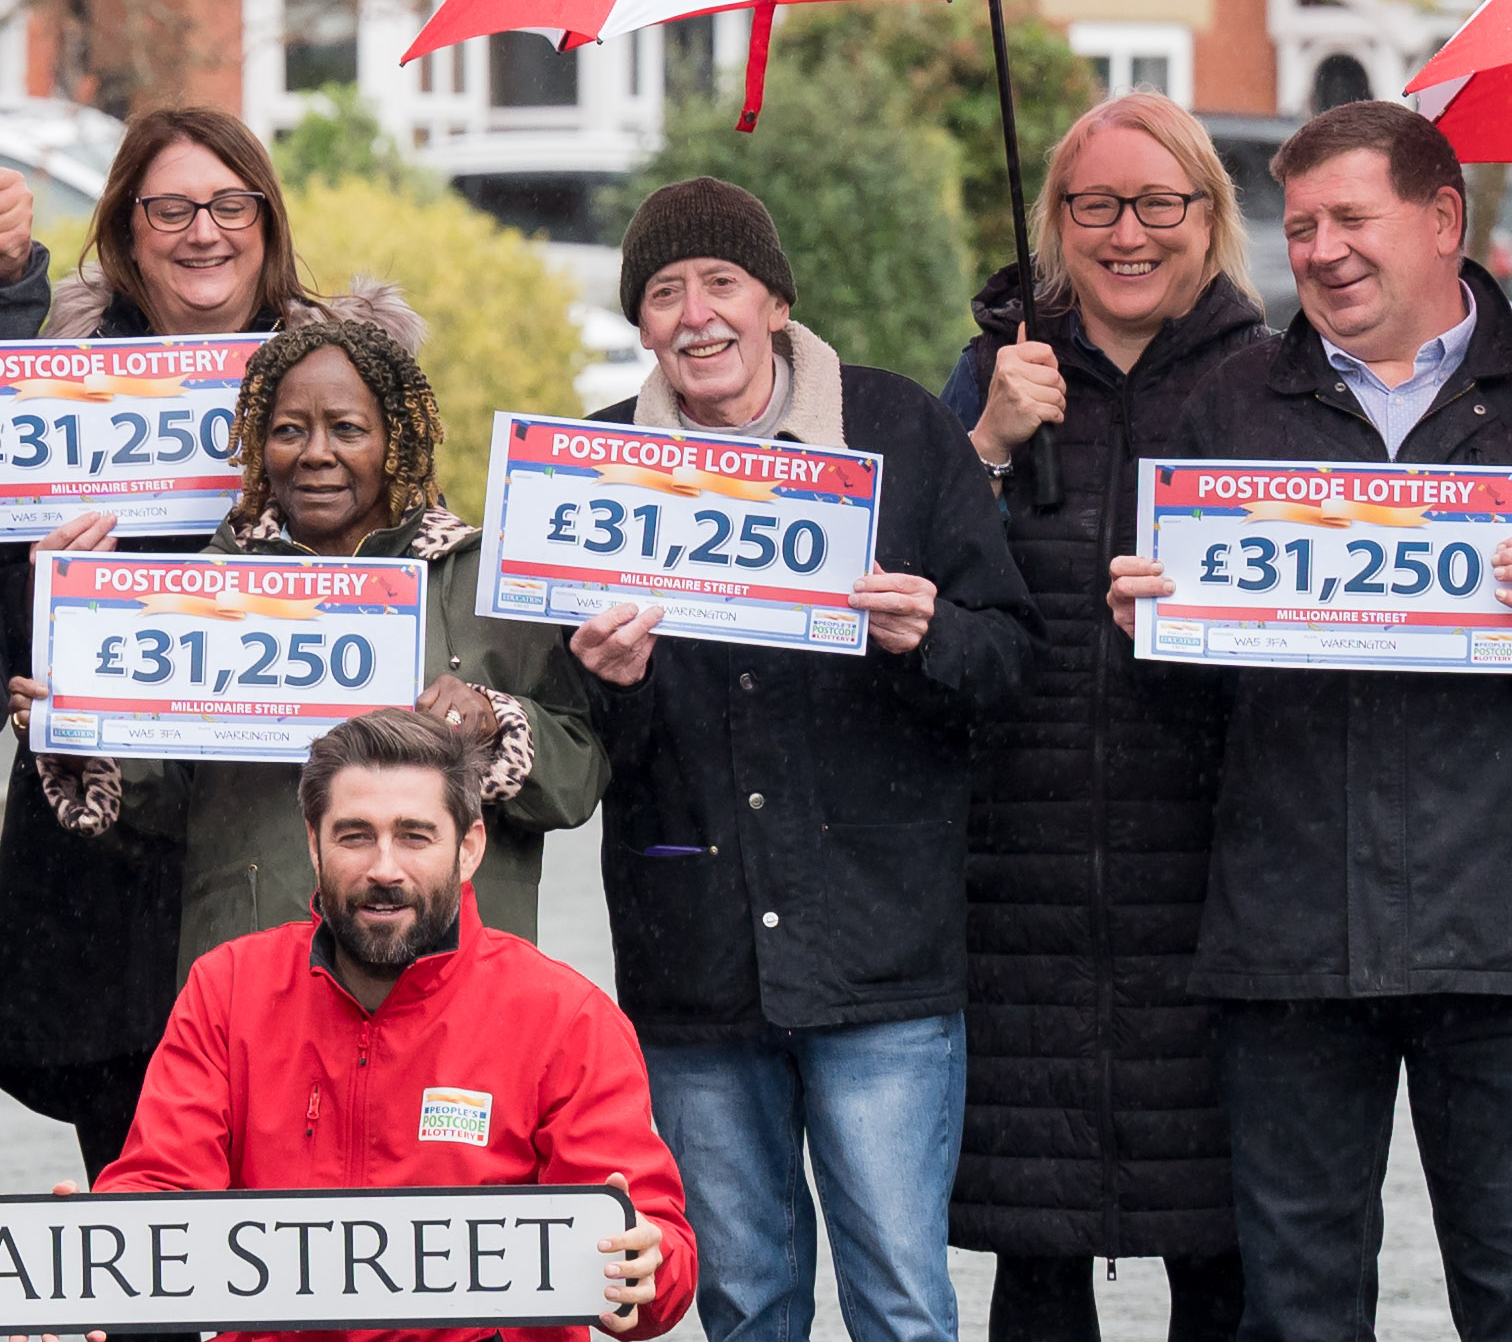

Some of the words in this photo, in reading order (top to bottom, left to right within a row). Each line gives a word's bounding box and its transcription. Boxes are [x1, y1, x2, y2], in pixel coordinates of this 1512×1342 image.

[113, 350, 229, 374] LOTTERY
[552, 433, 698, 470] POSTCODE
[705, 450, 825, 483] LOTTERY
[51, 481, 128, 494] MILLIONAIRE
[130, 479, 175, 491] STREET
[1198, 475, 1345, 500] POSTCODE
[1353, 479, 1475, 504] LOTTERY
[11, 512, 37, 522] WA5
[42, 512, 63, 522] 3FA
[547, 499, 827, 574] £31,250
[1200, 537, 1482, 603] £31,250
[95, 568, 240, 593] POSTCODE
[248, 572, 368, 596] LOTTERY
[621, 573, 700, 591] MILLIONAIRE
[703, 582, 750, 596] STREET
[577, 597, 602, 608] WA5
[663, 606, 737, 622] WARRINGTON
[1276, 610, 1359, 621] MILLIONAIRE
[1362, 613, 1407, 623] STREET
[813, 625, 856, 636] POSTCODE
[1235, 637, 1260, 647] WA5
[1265, 637, 1288, 648] 3FA
[1321, 638, 1396, 650] WARRINGTON
[95, 630, 374, 694] £31,250
[171, 701, 252, 713] MILLIONAIRE
[255, 704, 301, 715] STREET
[129, 729, 154, 739] WA5
[159, 730, 181, 739] 3FA
[214, 730, 290, 741] WARRINGTON
[430, 1106, 478, 1117] PEOPLE'S
[422, 1115, 485, 1132] POSTCODE
[428, 1129, 476, 1139] LOTTERY
[226, 1216, 574, 1297] STREET
